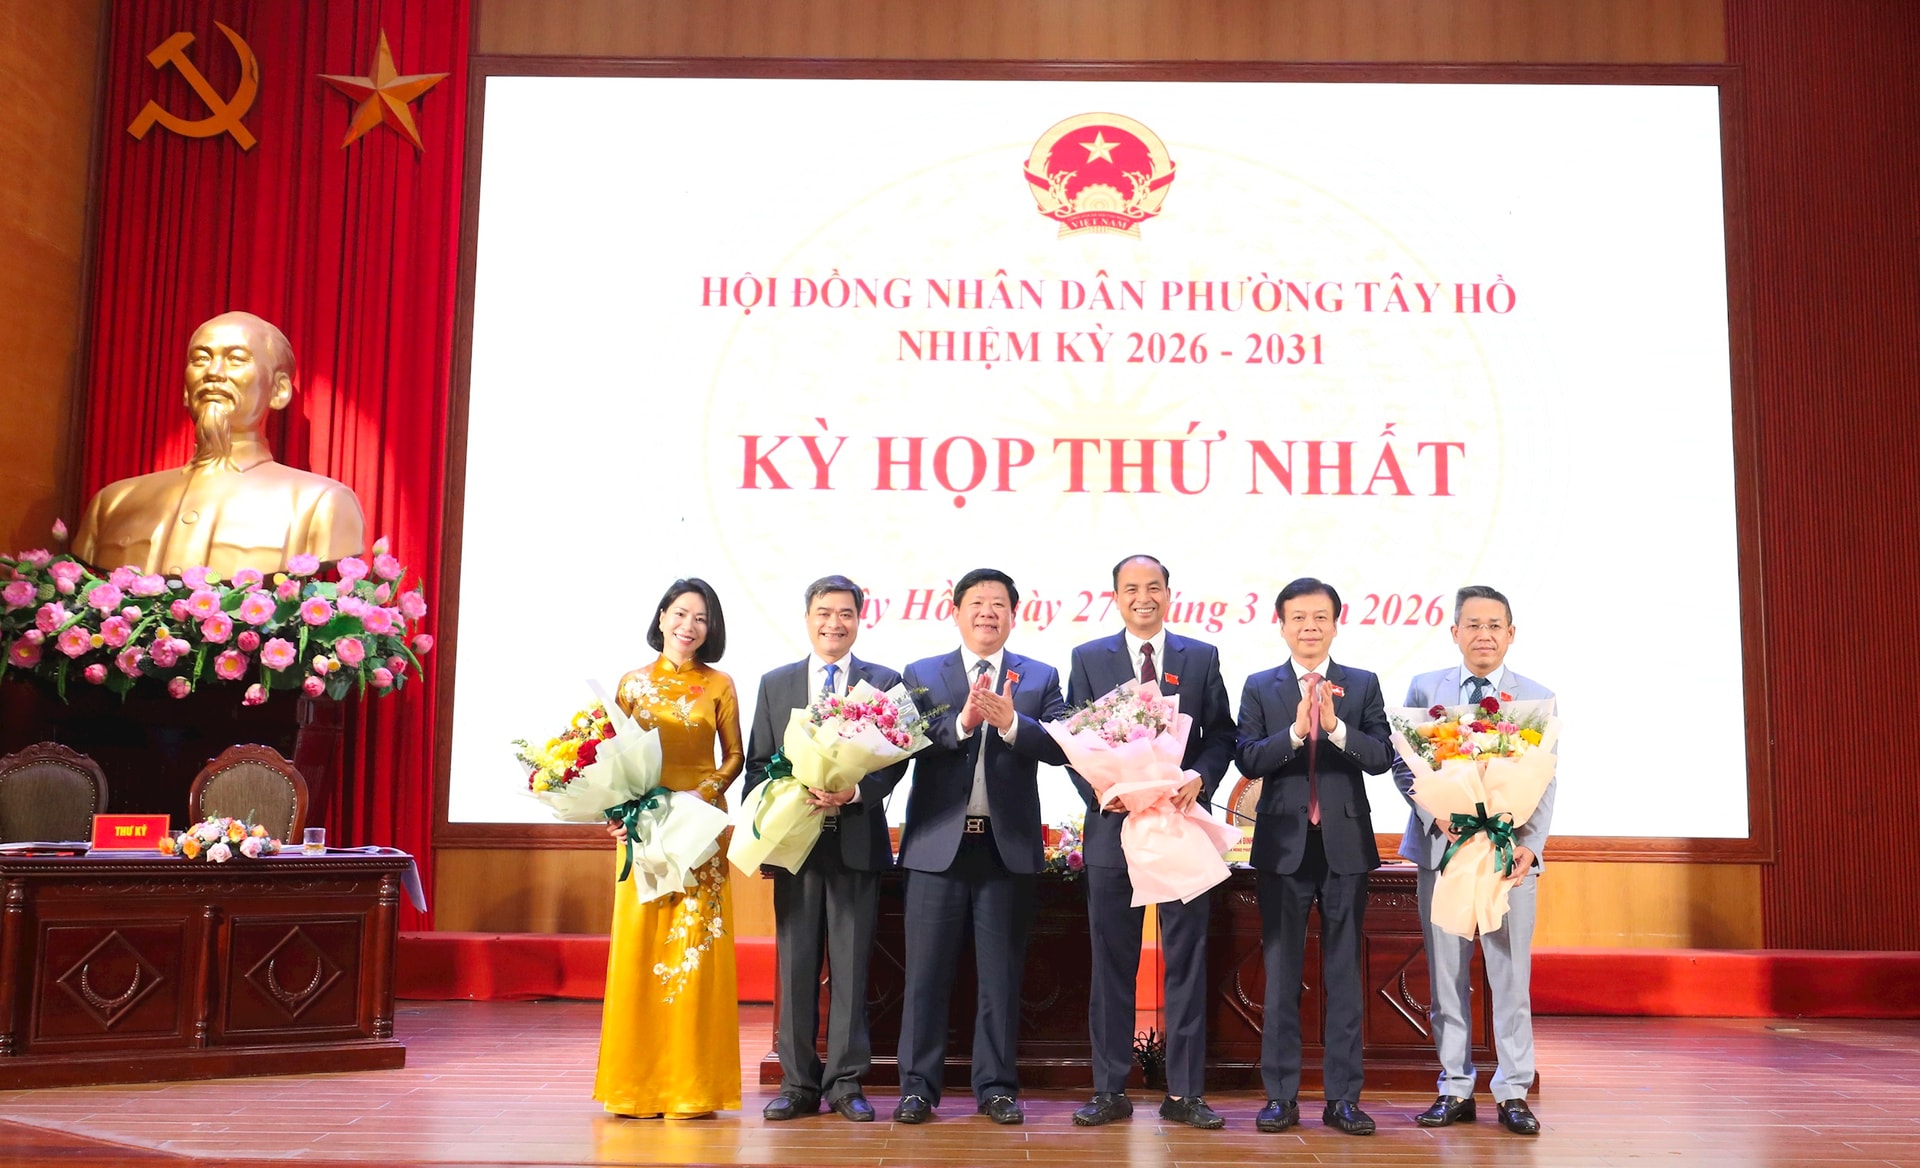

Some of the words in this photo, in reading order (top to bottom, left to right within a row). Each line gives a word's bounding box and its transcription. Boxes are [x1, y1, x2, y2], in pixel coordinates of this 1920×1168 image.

[701, 272, 778, 316] HỘI
[790, 269, 912, 309] ĐỒNG
[926, 268, 1046, 310] NHÂN
[1058, 269, 1146, 311] DÂN
[1161, 272, 1344, 314] PHƯỜNG
[1354, 272, 1441, 314] TÂY
[1454, 274, 1517, 315] HỒ
[897, 326, 1042, 371] NHIỆM
[1055, 323, 1114, 364] KỲ
[1126, 331, 1209, 364] 2026
[1245, 333, 1325, 365] 2031
[738, 417, 847, 490] KỲ
[873, 436, 1037, 509] HỌP
[1052, 420, 1228, 496] THỨ
[1246, 422, 1466, 497] NHẤT
[860, 588, 891, 629] ây
[1010, 589, 1062, 631] ày
[1072, 590, 1115, 622] 27
[1163, 591, 1228, 633] áng
[1238, 592, 1259, 624] 3
[1360, 593, 1445, 626] 2026
